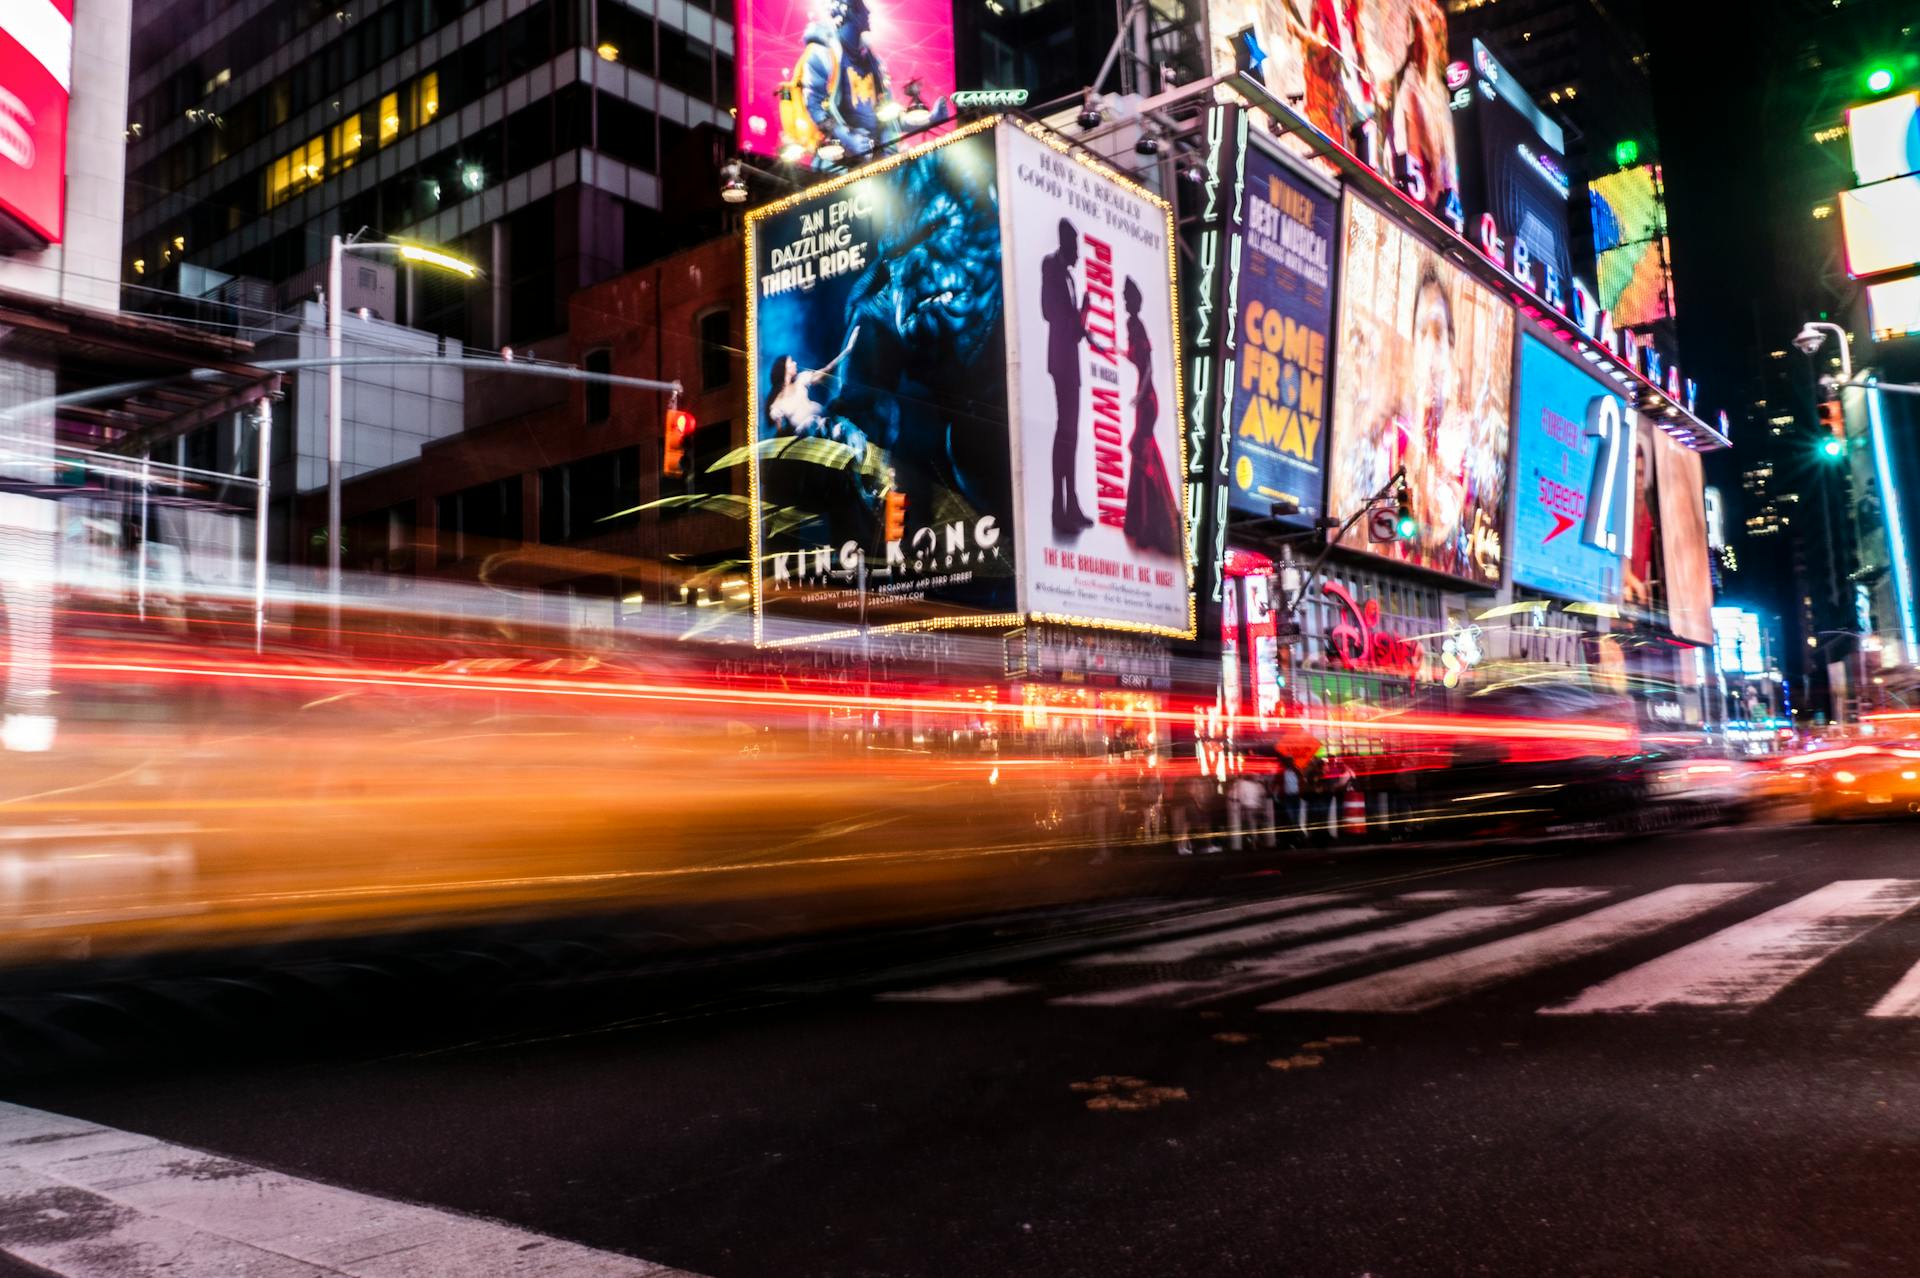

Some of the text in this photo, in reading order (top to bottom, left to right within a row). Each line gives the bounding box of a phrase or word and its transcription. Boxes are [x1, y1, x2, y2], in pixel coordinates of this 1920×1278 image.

[1249, 194, 1280, 240] BEST
[771, 224, 853, 271] DAZZLING
[761, 258, 816, 298] THRILL
[1083, 232, 1119, 366] PRETTY
[1245, 300, 1326, 376] COME
[1242, 343, 1323, 420] FROM
[1238, 394, 1321, 462] AWAY
[1541, 407, 1578, 449] FOREVER
[1091, 387, 1128, 532] WOMAN
[1592, 395, 1638, 559] 21
[773, 515, 1001, 582] KING KONG
[774, 546, 1001, 592] ALIVE ROADWAY
[1044, 548, 1058, 567] THE
[1061, 551, 1076, 569] BIG
[1078, 554, 1120, 577] BROADWAY
[1122, 673, 1149, 688] SONY
